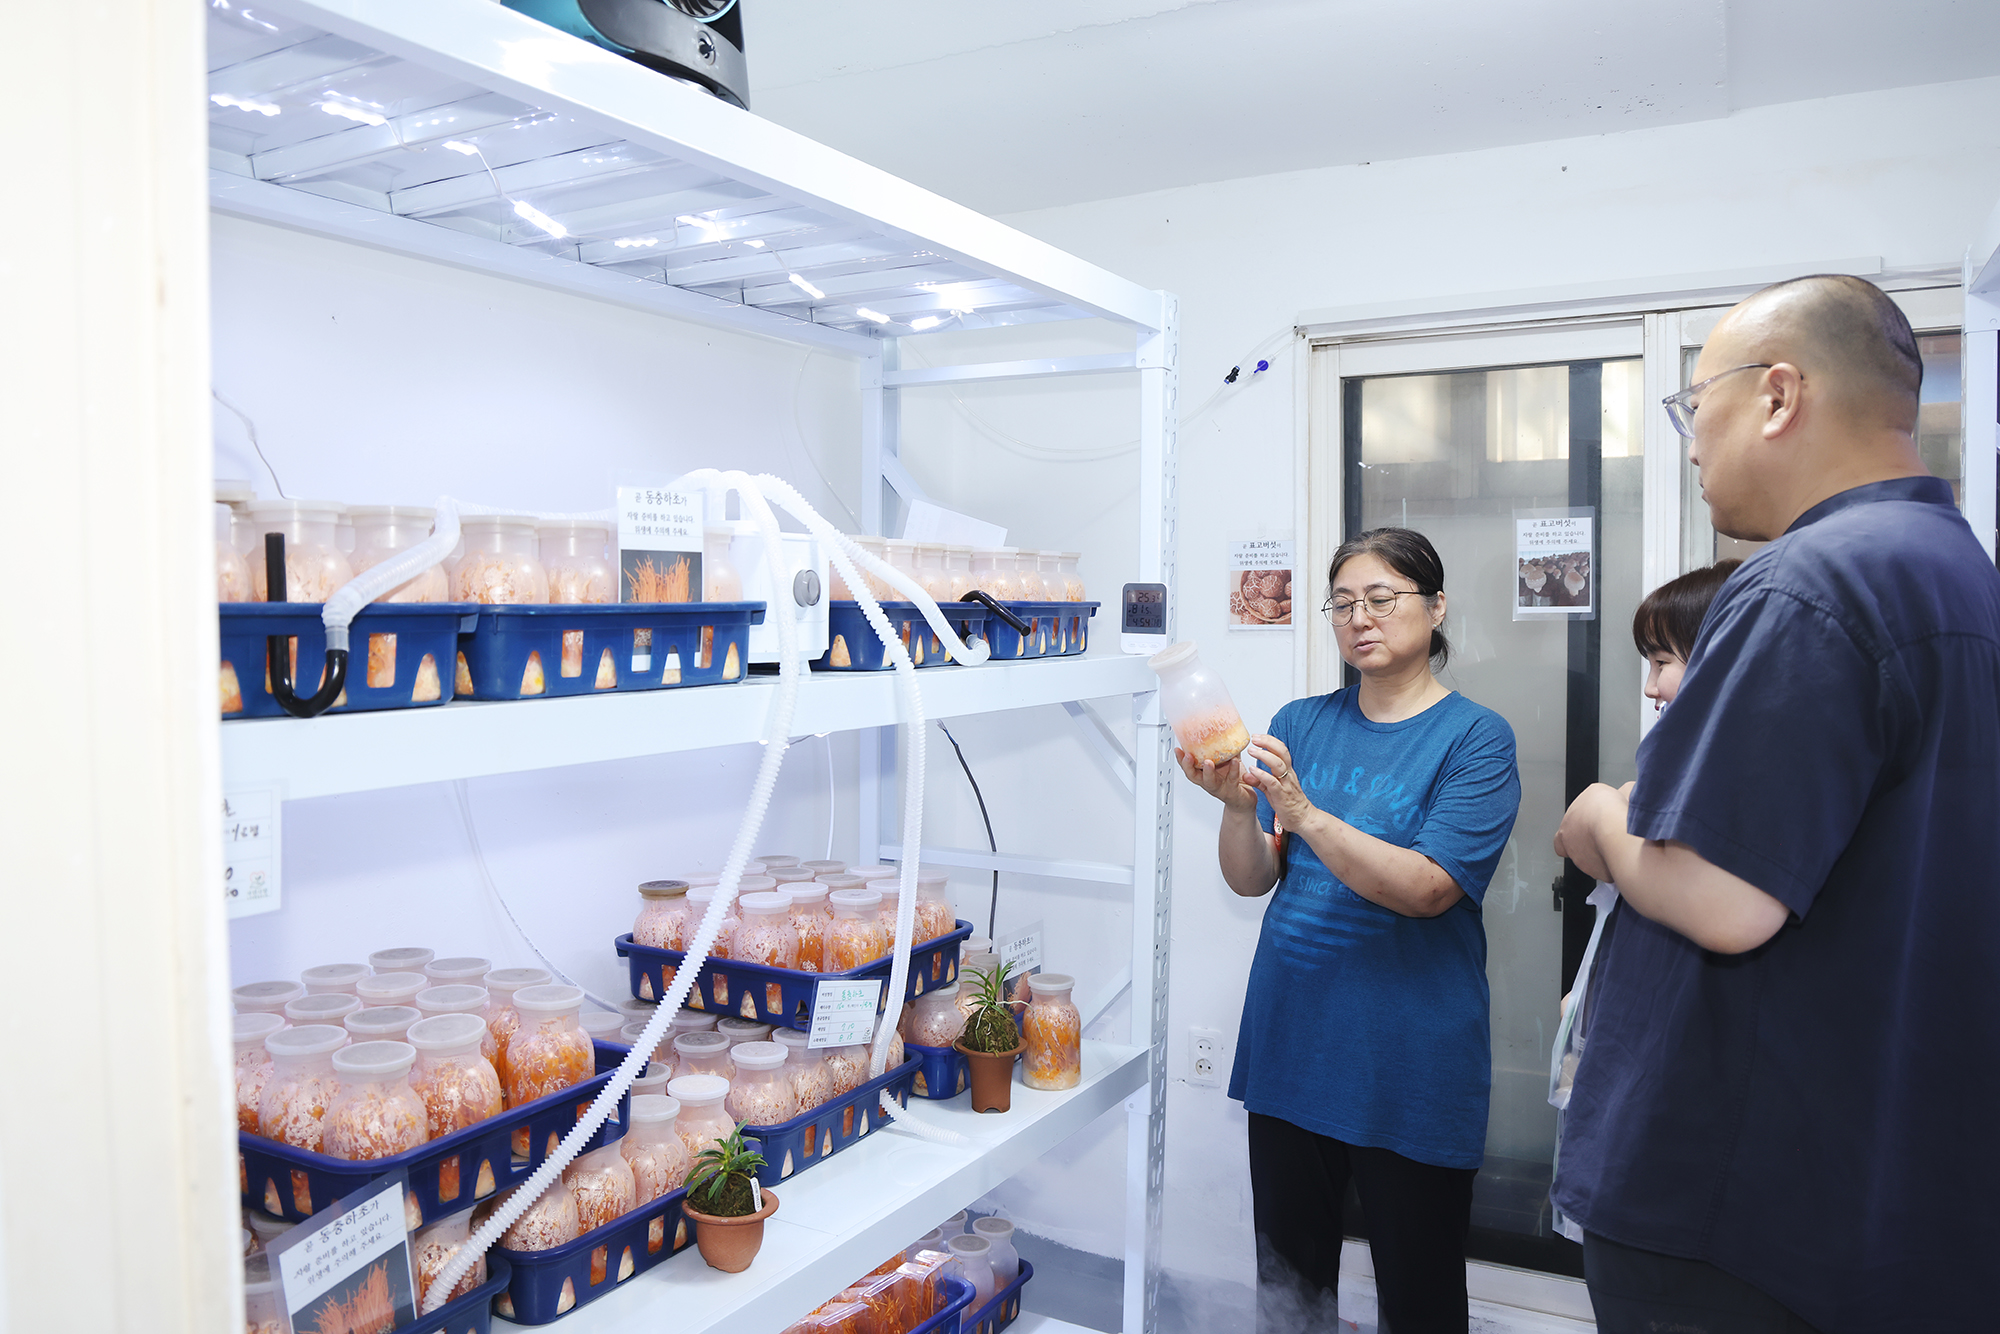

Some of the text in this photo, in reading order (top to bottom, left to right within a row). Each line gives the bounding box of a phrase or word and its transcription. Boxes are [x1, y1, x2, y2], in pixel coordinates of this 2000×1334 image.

[646, 490, 687, 506] 동충하초가
[1540, 519, 1576, 527] 표고버섯이
[1343, 766, 1365, 796] &
[1297, 875, 1332, 896] SINCE
[304, 1200, 379, 1254] 곧 동충하초가
[315, 1246, 338, 1266] 준비를
[342, 1234, 357, 1248] 하고
[360, 1213, 392, 1236] 있습니다.
[307, 1264, 331, 1285] 위생에
[334, 1248, 357, 1267] 주의해
